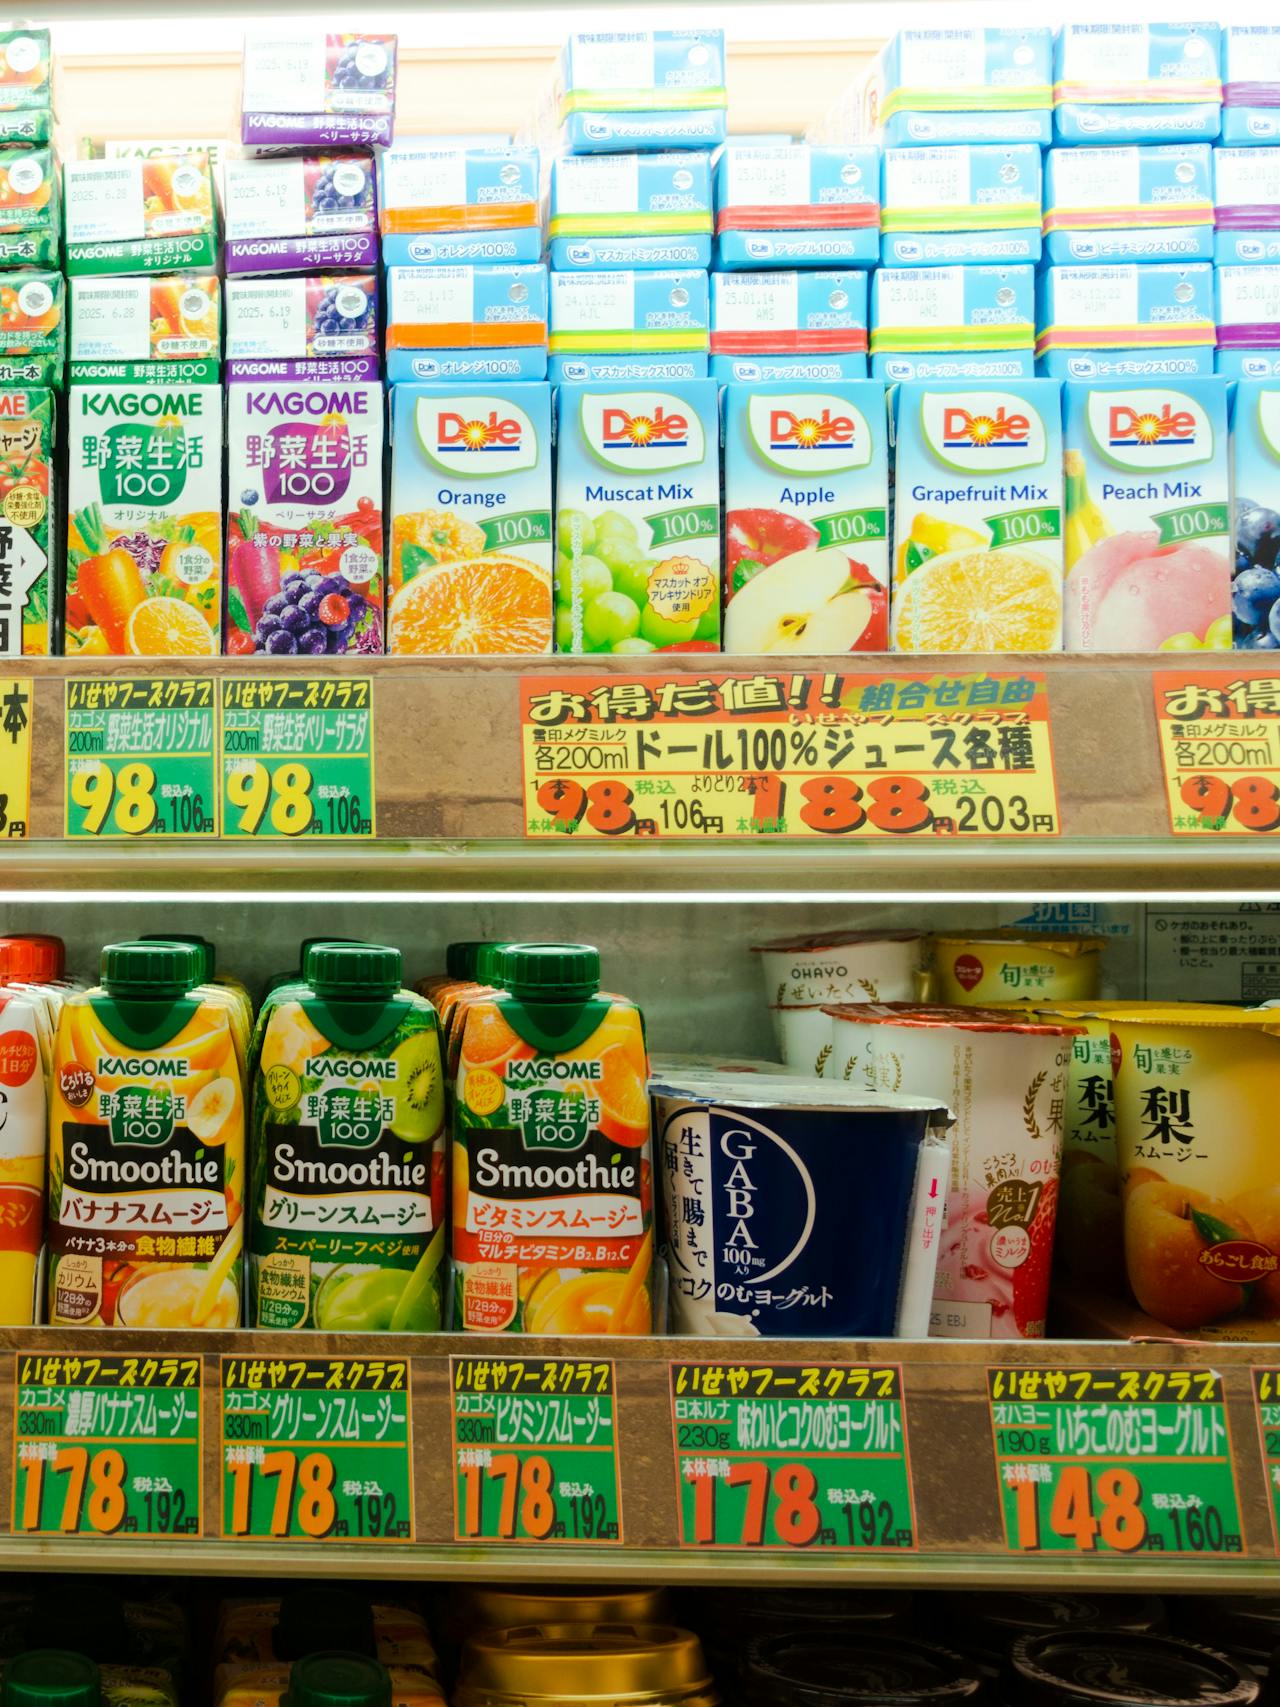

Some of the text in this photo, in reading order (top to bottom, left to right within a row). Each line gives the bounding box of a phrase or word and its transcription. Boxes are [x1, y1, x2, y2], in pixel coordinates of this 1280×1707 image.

[68, 243, 124, 261] KAGOME
[143, 252, 193, 266] オリジナル
[303, 251, 365, 264] ベリーサラダ
[82, 393, 203, 416] KAGOME
[246, 391, 368, 415] KAGOME
[437, 411, 522, 448] Dole
[602, 406, 689, 443] Dole
[769, 408, 855, 445] Dole
[943, 405, 1031, 442] Dole
[1108, 403, 1196, 440] Dole
[81, 434, 204, 471] 野菜生活
[245, 434, 369, 470] 野菜生活
[114, 472, 171, 497] 100
[279, 472, 336, 496] 100
[585, 483, 694, 502] Muscat Mix
[779, 486, 836, 505] Apple
[911, 484, 1048, 504] Grapefruit Mix
[1102, 481, 1202, 500] Peach Mix
[437, 487, 507, 509] Orange
[114, 510, 170, 521] オリジナル
[275, 510, 337, 521] ベリーサラダ
[1001, 514, 1055, 541] 100%
[1169, 511, 1225, 540] 100%
[253, 532, 358, 548] 紫の野菜と果実
[496, 514, 546, 544] 100%
[650, 590, 712, 601] アレキサンドリア
[791, 965, 849, 980] OHAYO
[97, 1057, 189, 1078] KAGOME
[305, 1058, 397, 1080] KAGOME
[507, 1060, 601, 1081] KAGOME
[98, 1093, 187, 1122] 野菜生活
[306, 1095, 396, 1122] 野菜生活
[510, 1097, 601, 1124] 野菜生活
[1138, 1085, 1196, 1145] 梨
[122, 1120, 162, 1140] 100
[330, 1122, 371, 1141] 100
[535, 1124, 577, 1143] 100
[68, 1140, 219, 1185] Smoothie
[273, 1143, 427, 1188] Smoothie
[1133, 1145, 1209, 1162] スムージー
[475, 1146, 636, 1191] Smoothie
[679, 1127, 709, 1268] 生きて腸まで
[719, 1129, 760, 1250] GABA
[61, 1198, 225, 1226] バナナスムージー
[267, 1198, 428, 1228] グリーンスムージー
[472, 1203, 639, 1231] ビタミンスムージー
[1198, 1249, 1279, 1272] あらごし食感
[58, 1272, 98, 1290] カリウム
[675, 1399, 732, 1420] 日本ルナ
[993, 1404, 1051, 1425] オハヨー
[678, 1425, 731, 1450] 230g
